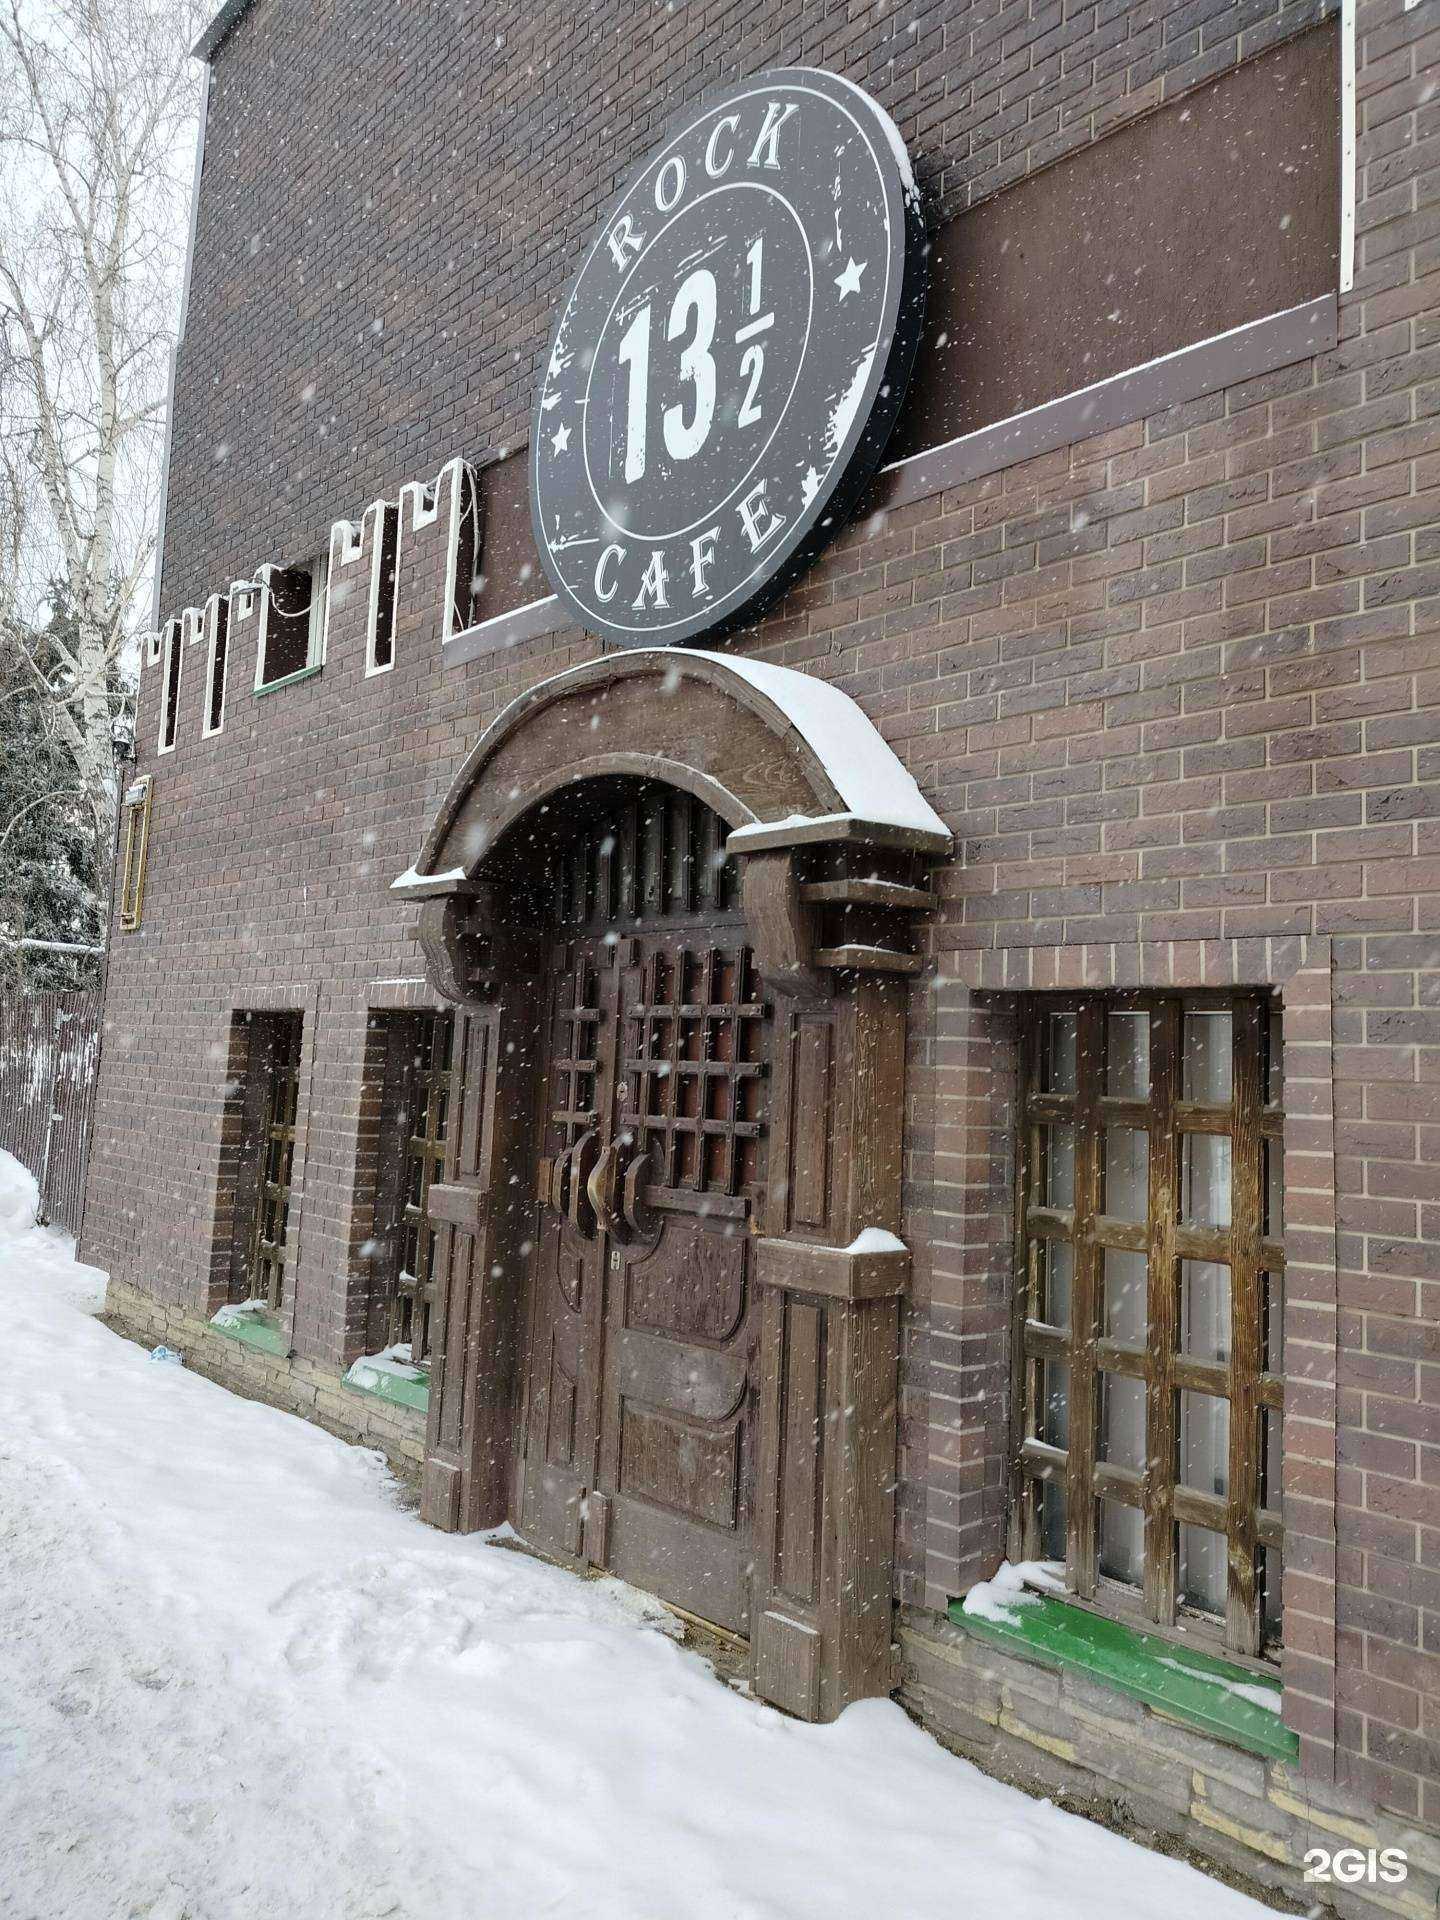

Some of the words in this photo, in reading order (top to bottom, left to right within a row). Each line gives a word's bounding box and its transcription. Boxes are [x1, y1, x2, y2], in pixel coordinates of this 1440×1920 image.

[607, 102, 799, 274] ROCK
[618, 269, 718, 484] 13
[594, 478, 786, 611] CAFE
